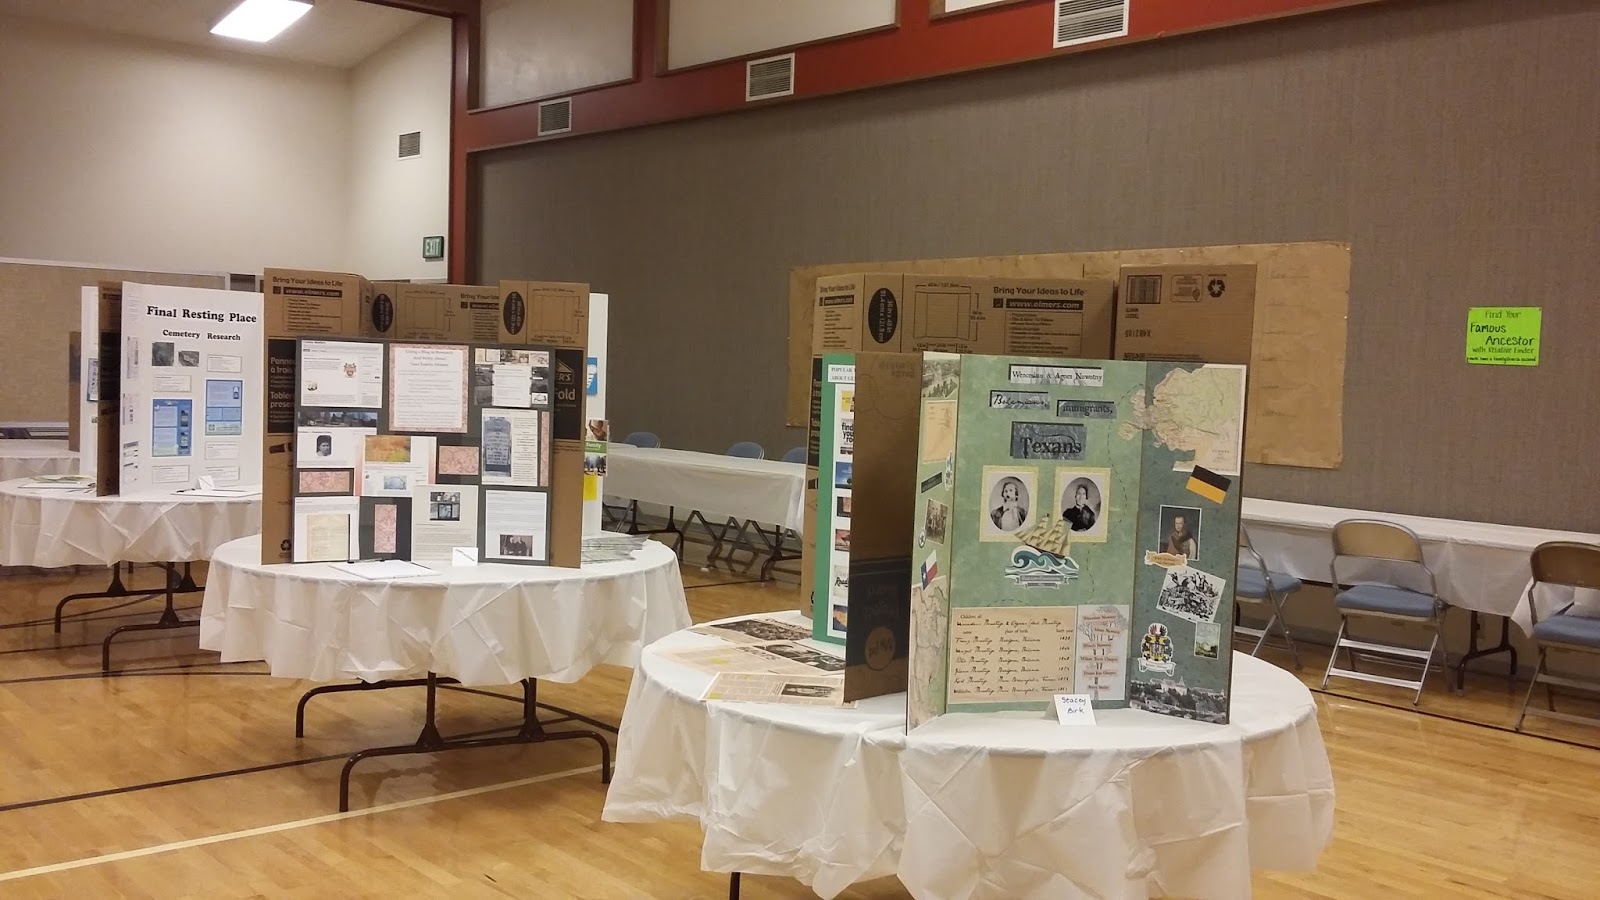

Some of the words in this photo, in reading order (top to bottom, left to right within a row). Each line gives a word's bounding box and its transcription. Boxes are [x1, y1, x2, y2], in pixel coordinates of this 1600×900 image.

[426, 239, 440, 256] EXIT
[273, 276, 289, 284] Bring
[994, 286, 1014, 295] Bring
[147, 306, 177, 318] Final
[182, 309, 224, 322] Resting
[229, 312, 256, 322] Place
[1485, 310, 1502, 318] Find
[1506, 310, 1522, 318] Your
[1470, 322, 1506, 332] Famous
[162, 330, 200, 338] Cemetery
[207, 332, 241, 340] Research
[1485, 336, 1535, 346] Ancestor
[1056, 372, 1072, 382] Agnes
[1062, 404, 1113, 416] immigrants,
[842, 432, 854, 440] you
[1020, 436, 1082, 459] Texans
[1062, 696, 1086, 706] Stacey
